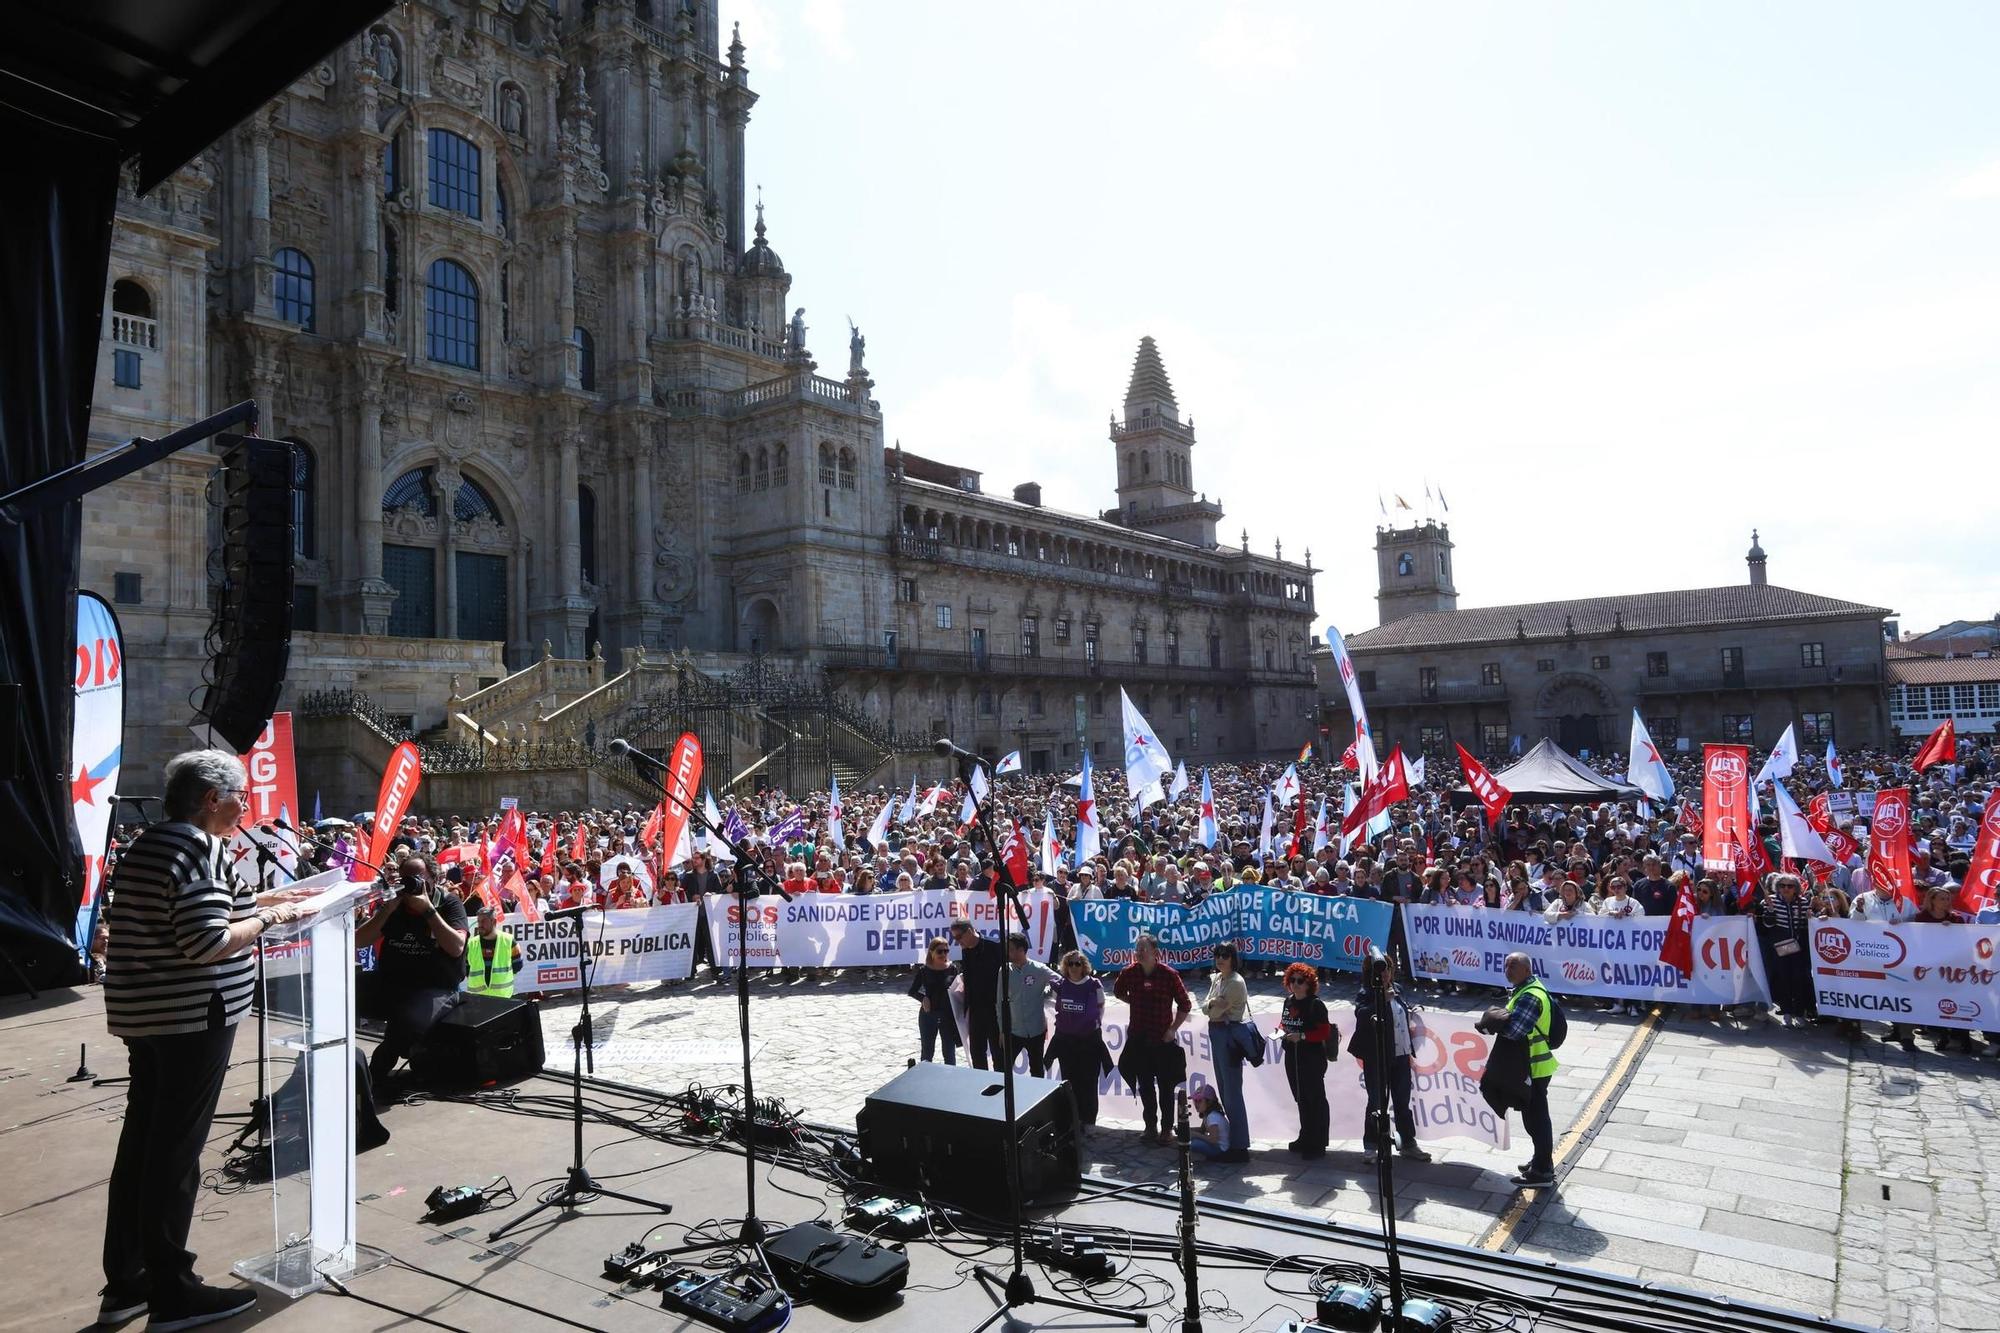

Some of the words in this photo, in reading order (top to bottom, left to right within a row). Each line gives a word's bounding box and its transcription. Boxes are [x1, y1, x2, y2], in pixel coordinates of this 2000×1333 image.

[1710, 757, 1740, 771] UGT
[1878, 803, 1900, 819] UGT
[728, 905, 778, 923] SOS
[787, 904, 869, 923] SANIDADE
[876, 900, 945, 920] PÚBLICA
[949, 901, 968, 918] EN
[1083, 902, 1120, 923] POR
[1128, 906, 1181, 927] UNHA
[1186, 892, 1264, 923] SANIDADE
[1271, 890, 1359, 923] PÚBLICA
[1158, 912, 1240, 945] CALIDADE
[1241, 912, 1262, 932] EN
[1269, 914, 1335, 942] GALIZA
[1414, 916, 1440, 935] POR
[1444, 917, 1483, 939] UNHA
[1487, 920, 1552, 946] SANIDADE
[1556, 922, 1626, 950] PÚBLICA
[526, 939, 614, 962] SANIDADE
[620, 933, 691, 955] PÚBLICA
[1259, 938, 1324, 959] DEREITOS
[1817, 932, 1846, 947] UGT
[1856, 940, 1890, 950] Servizos
[1856, 948, 1890, 958] Públicos
[540, 969, 577, 982] CCOO
[1452, 948, 1480, 968] Máis
[1562, 961, 1595, 981] Máis
[1601, 962, 1688, 989] CALIDADE
[1836, 969, 1859, 978] Galicia
[1819, 990, 1912, 1013] ESENCIAIS
